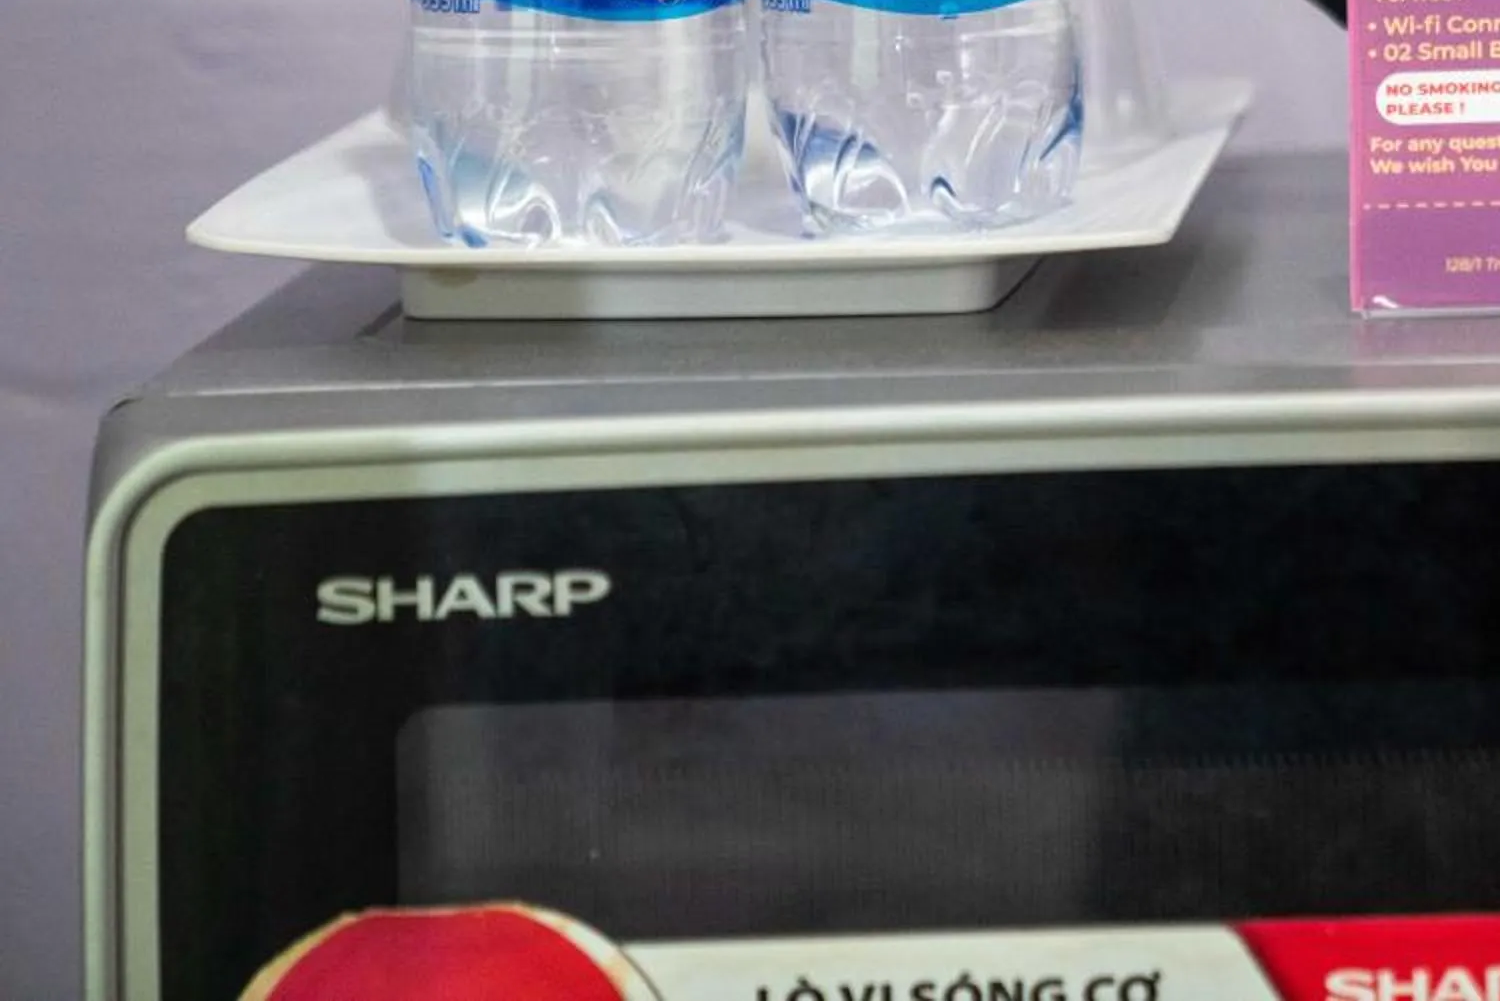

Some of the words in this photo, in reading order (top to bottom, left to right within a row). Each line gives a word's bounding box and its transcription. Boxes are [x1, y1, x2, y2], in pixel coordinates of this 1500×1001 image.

[1384, 15, 1440, 35] Wi-fi
[1384, 43, 1411, 61] 02
[1418, 41, 1482, 60] Small
[1386, 82, 1413, 97] NO
[1386, 102, 1454, 116] PLEASE
[1370, 135, 1401, 152] For
[1407, 137, 1443, 155] any
[1370, 158, 1402, 174] We
[1408, 156, 1455, 174] wish
[1458, 154, 1497, 172] You
[316, 567, 611, 625] SHARP
